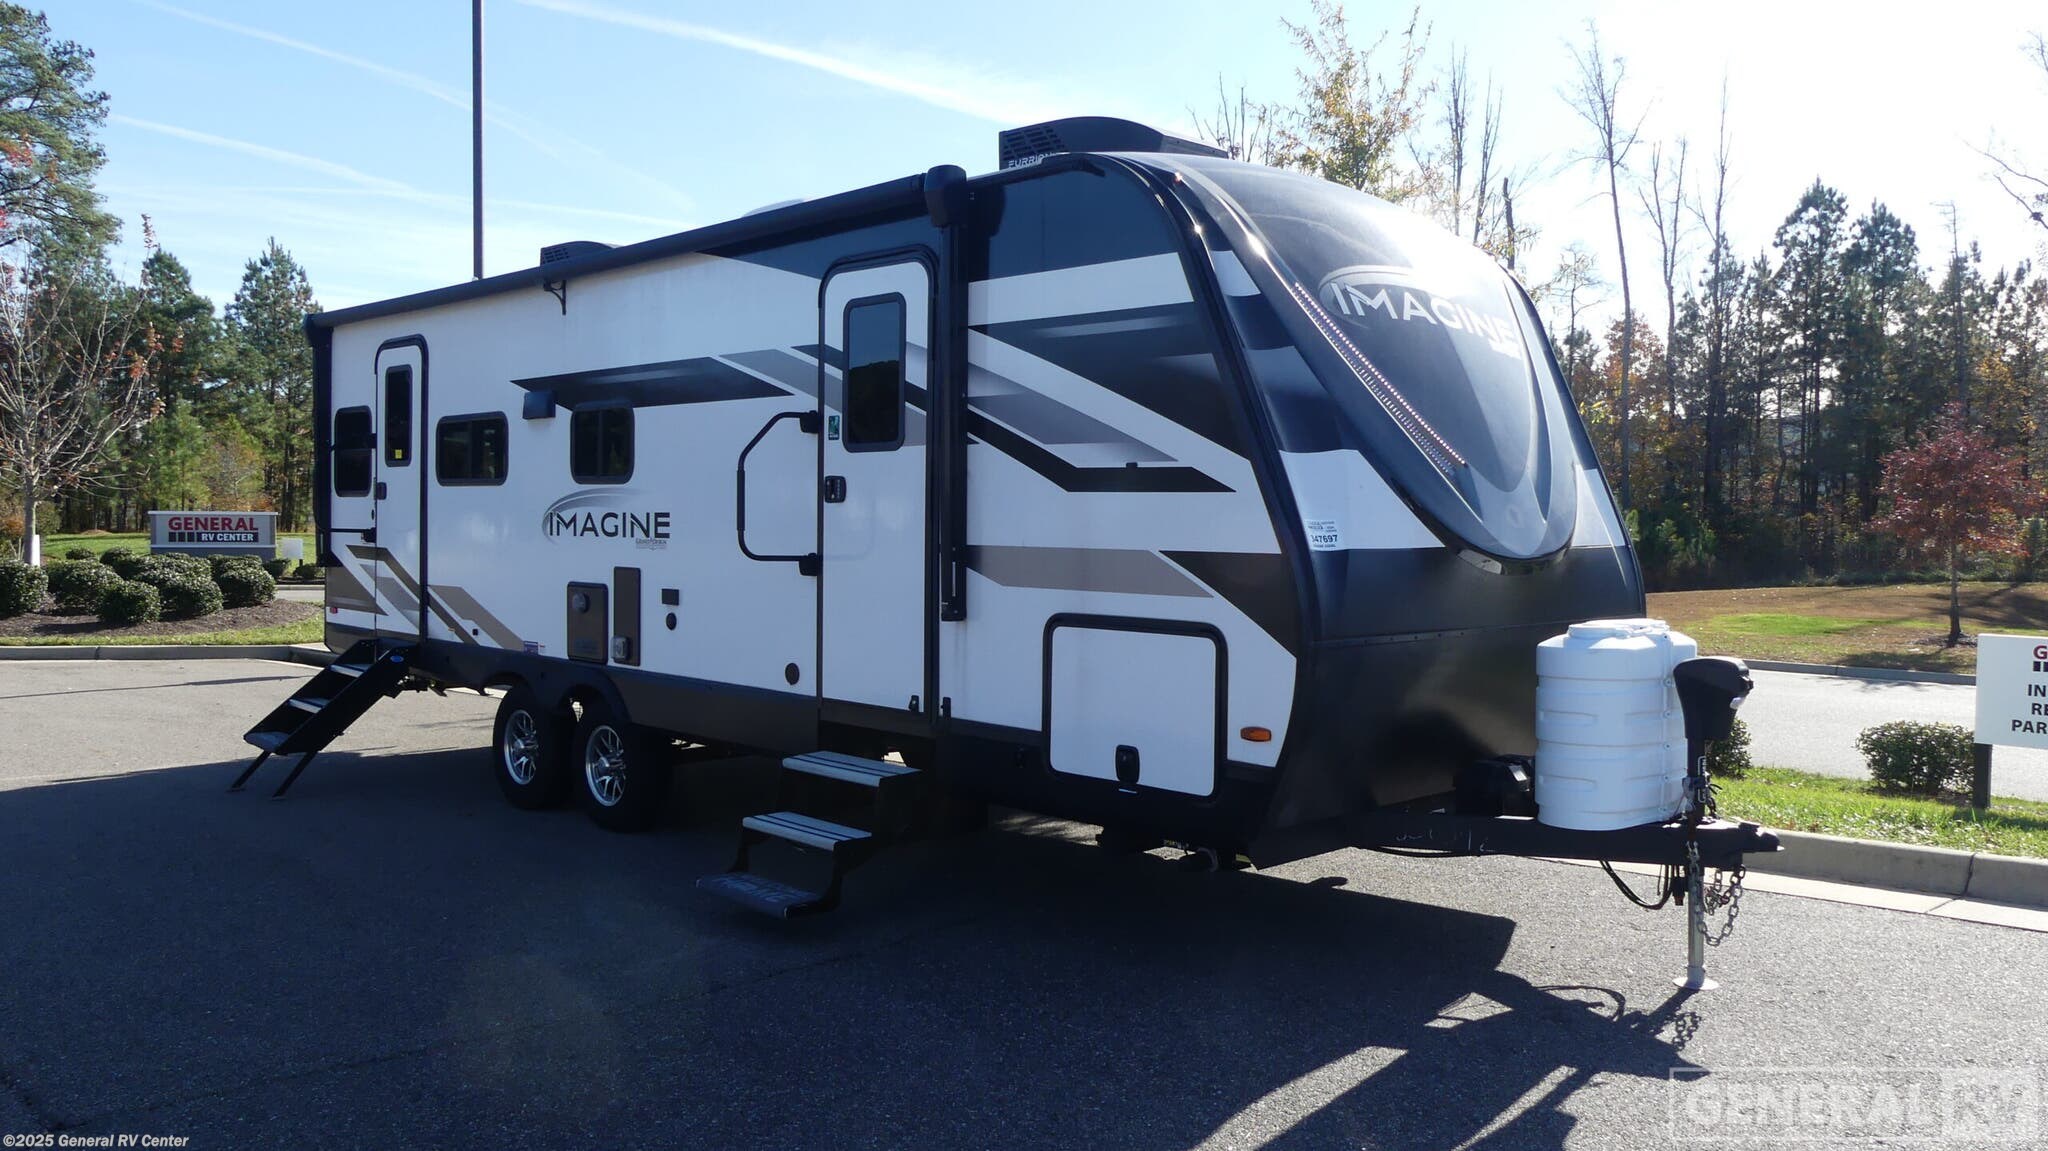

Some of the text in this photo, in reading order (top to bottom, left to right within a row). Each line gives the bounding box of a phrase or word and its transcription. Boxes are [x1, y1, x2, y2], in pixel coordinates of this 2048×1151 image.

[1330, 280, 1521, 346] IMAGINE
[168, 516, 259, 531] GENERAL
[549, 511, 671, 539] IMAGINE
[201, 533, 254, 541] RV CENTER
